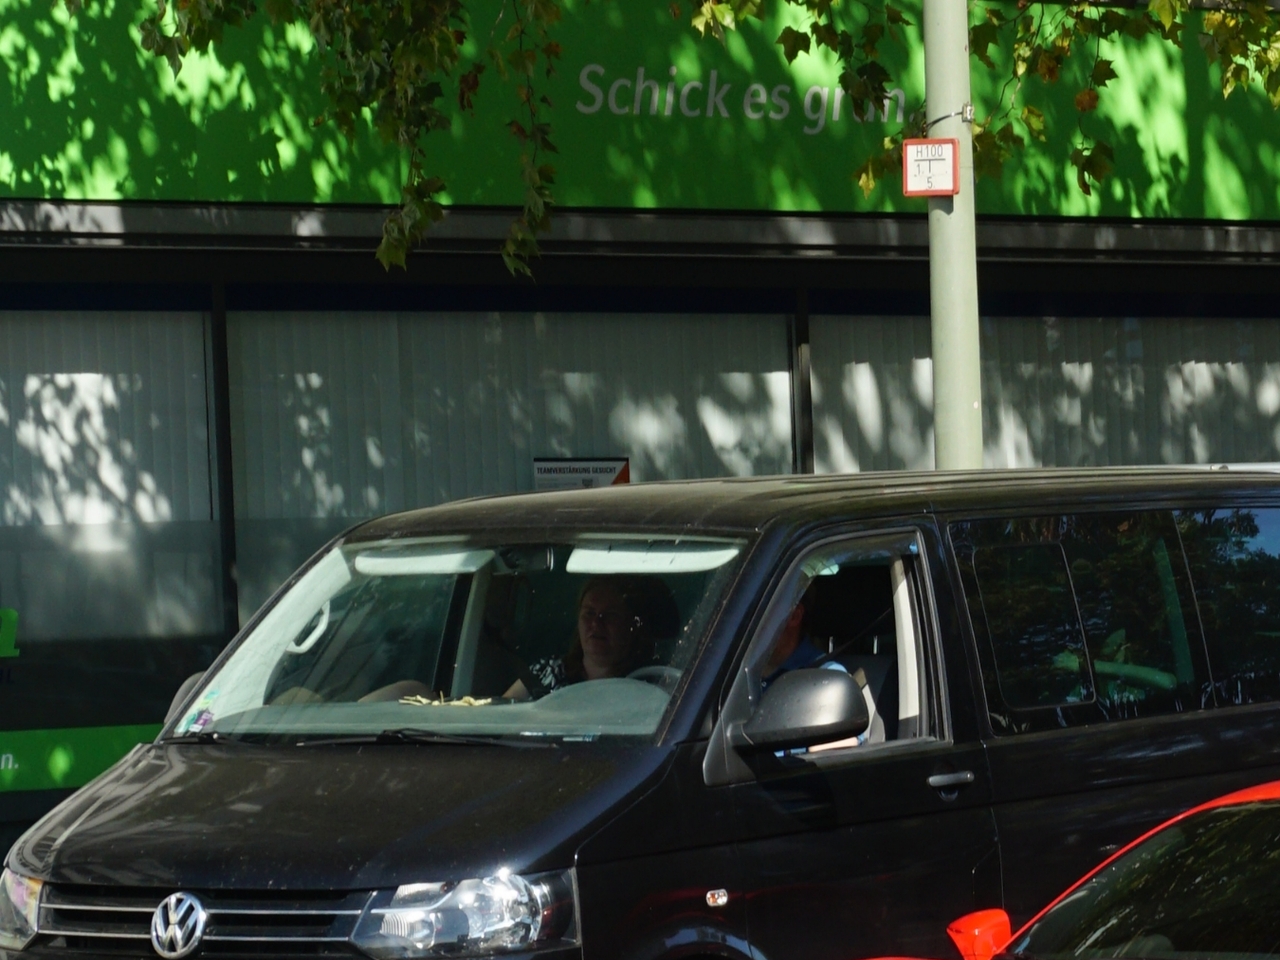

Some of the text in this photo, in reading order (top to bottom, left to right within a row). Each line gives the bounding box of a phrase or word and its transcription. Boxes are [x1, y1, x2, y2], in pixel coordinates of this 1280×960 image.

[575, 63, 916, 135] Schick es grn.
